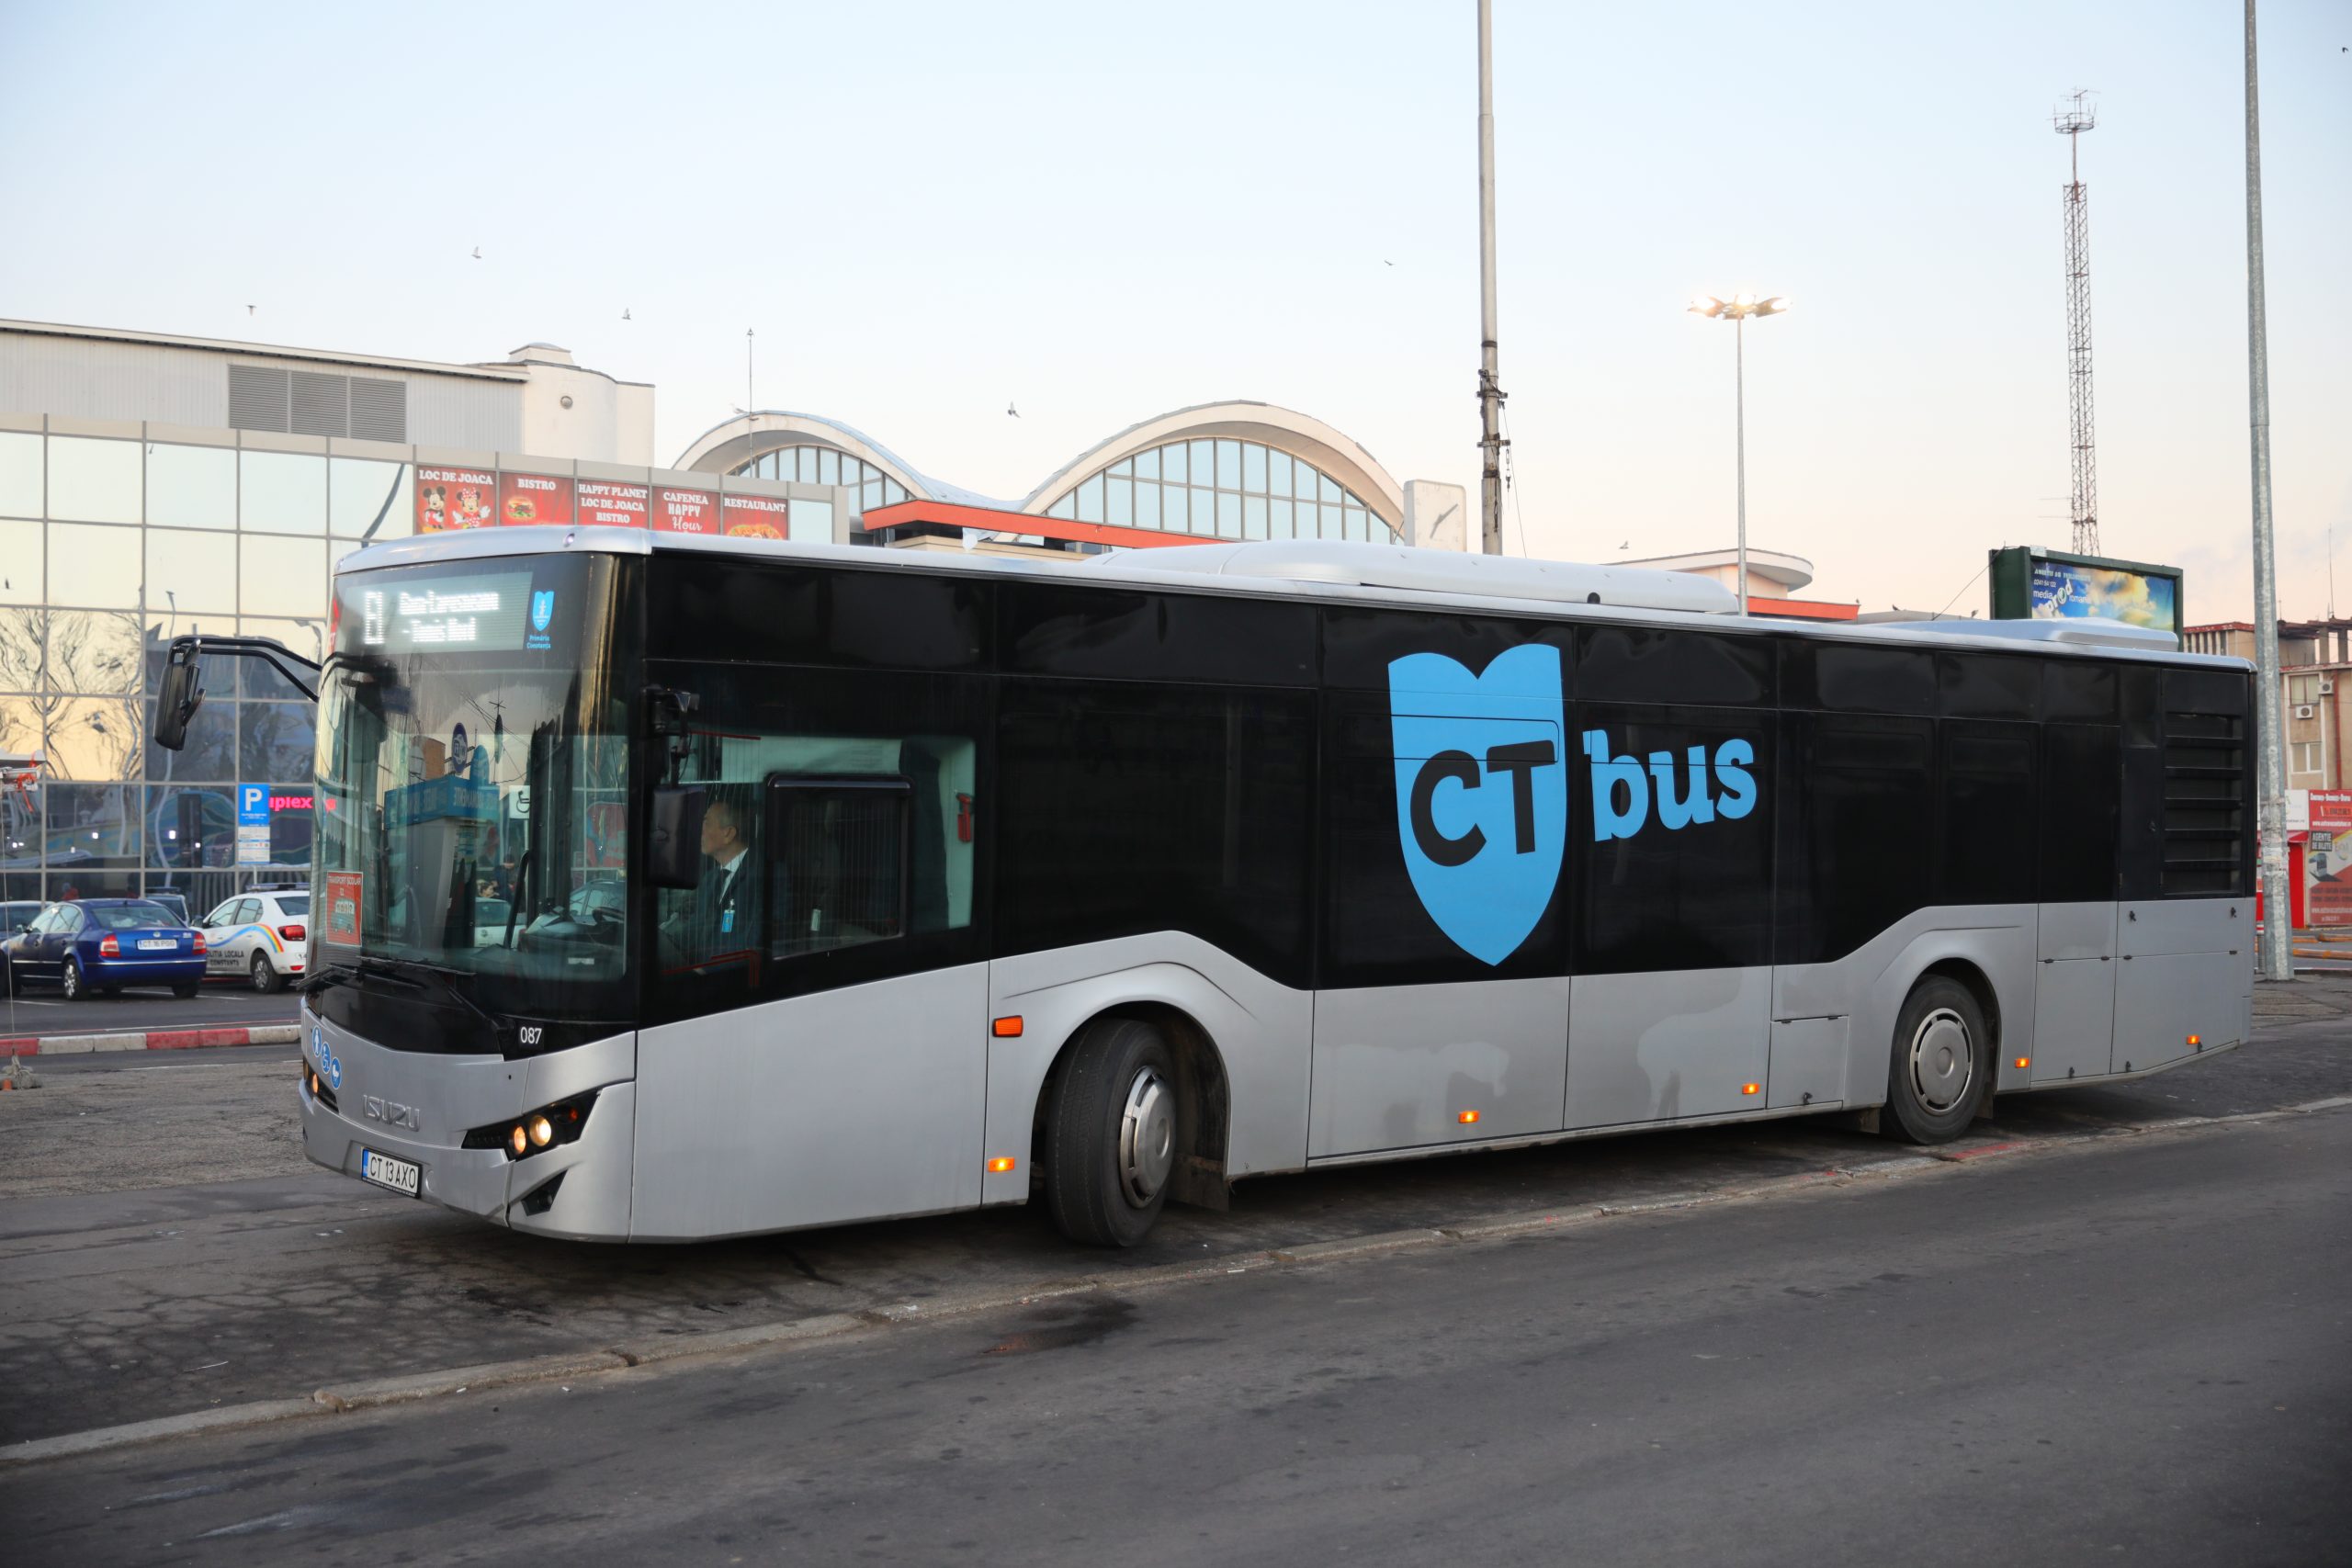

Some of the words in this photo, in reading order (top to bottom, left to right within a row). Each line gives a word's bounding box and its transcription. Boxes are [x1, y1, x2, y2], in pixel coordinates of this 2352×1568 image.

[419, 470, 441, 479] LOC
[442, 471, 457, 481] DE
[458, 473, 493, 485] JOACA
[517, 479, 557, 491] BISTRO
[579, 484, 610, 495] HAPPY
[611, 486, 647, 499] PLANET
[663, 491, 708, 504] CAFENEA
[581, 498, 599, 508] LOC
[600, 499, 614, 509] DE
[615, 501, 645, 512] JOACA
[668, 503, 701, 517] HAPPY
[724, 498, 786, 513] RESTAURANT
[596, 512, 630, 524] BISTRO
[673, 516, 703, 531] Hour
[2033, 590, 2053, 599] media
[245, 788, 263, 811] P
[1410, 739, 1555, 867] CT
[1582, 729, 1757, 841] bus
[520, 1026, 542, 1044] 087
[363, 1094, 420, 1132] ISUZU
[369, 1156, 382, 1179] CT
[385, 1160, 394, 1182] 13
[395, 1164, 416, 1188] AXO
